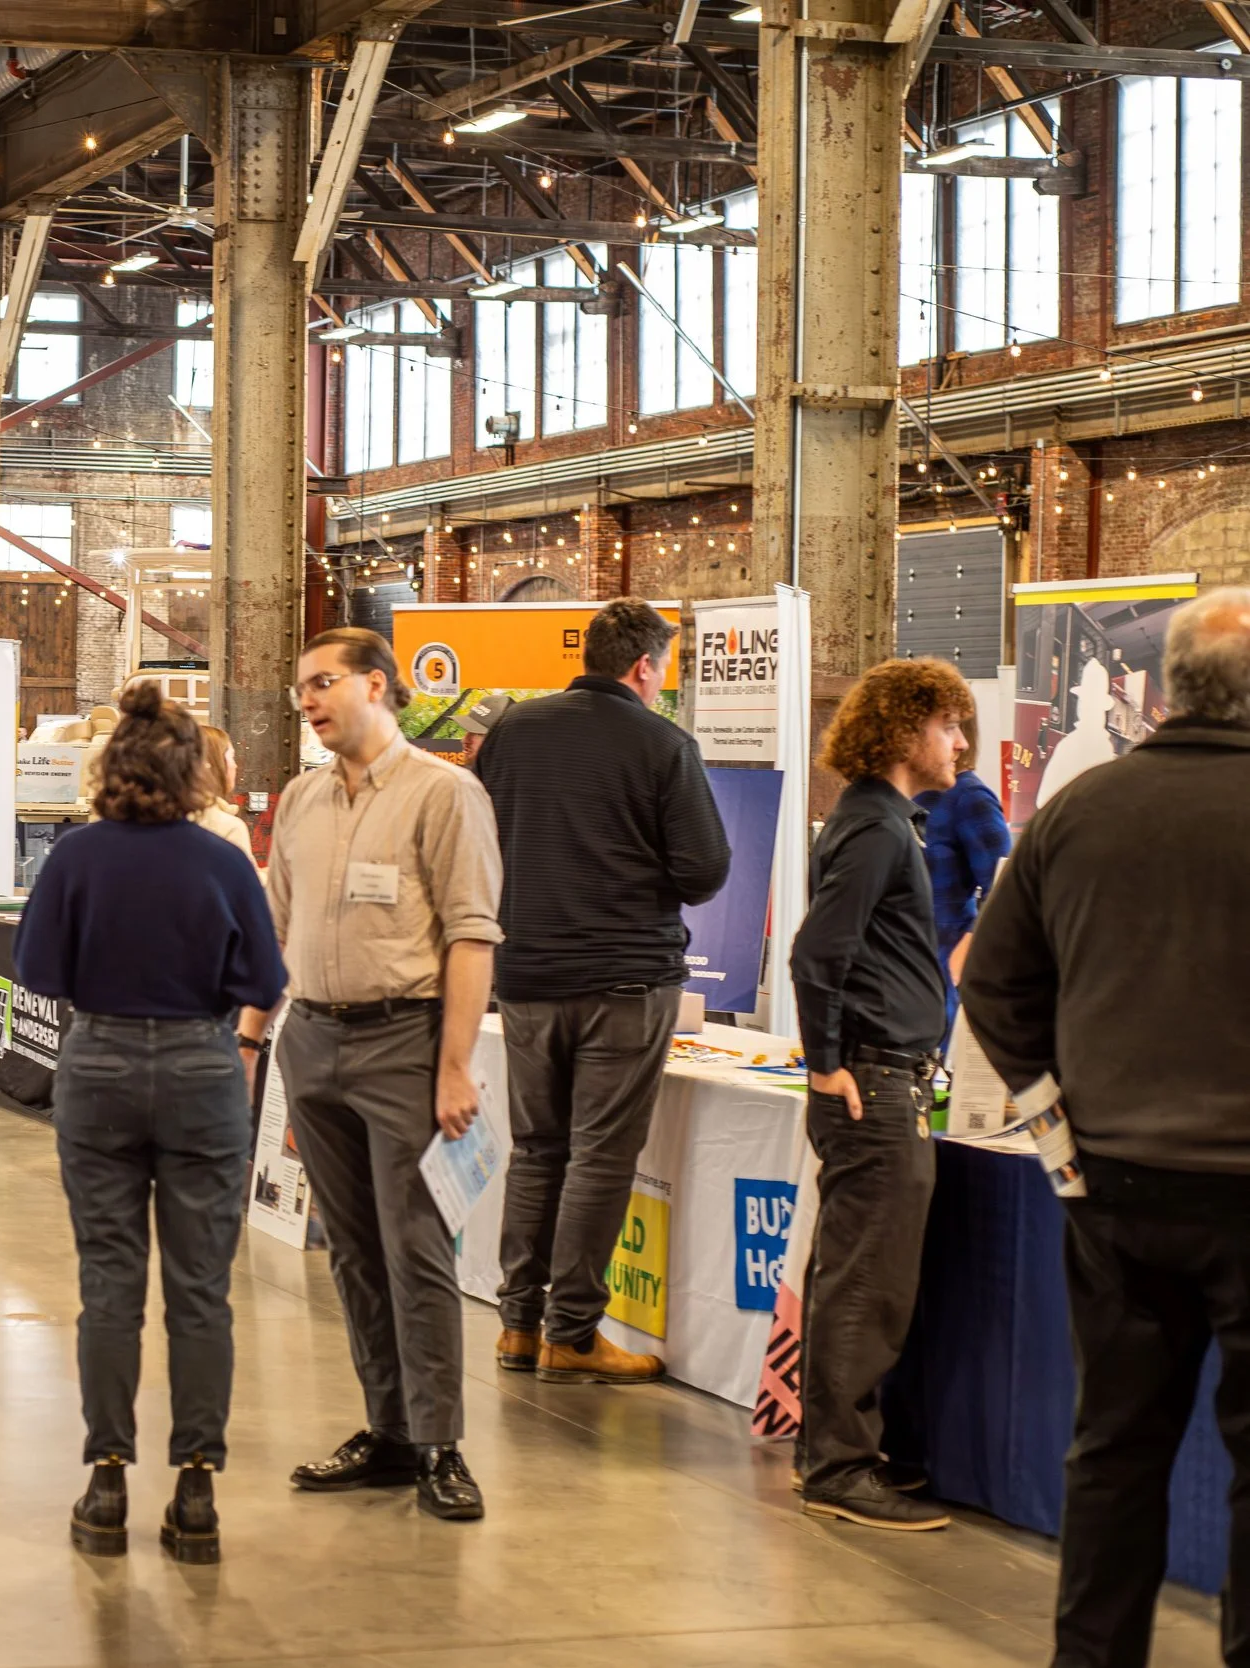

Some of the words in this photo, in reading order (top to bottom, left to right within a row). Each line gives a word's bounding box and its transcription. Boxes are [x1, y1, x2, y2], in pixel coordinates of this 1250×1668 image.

[434, 662, 443, 679] 5
[701, 657, 778, 682] ENERGY
[32, 756, 50, 765] Life
[12, 983, 60, 1027] RENEWAL
[18, 1017, 60, 1051] ANDERSEN
